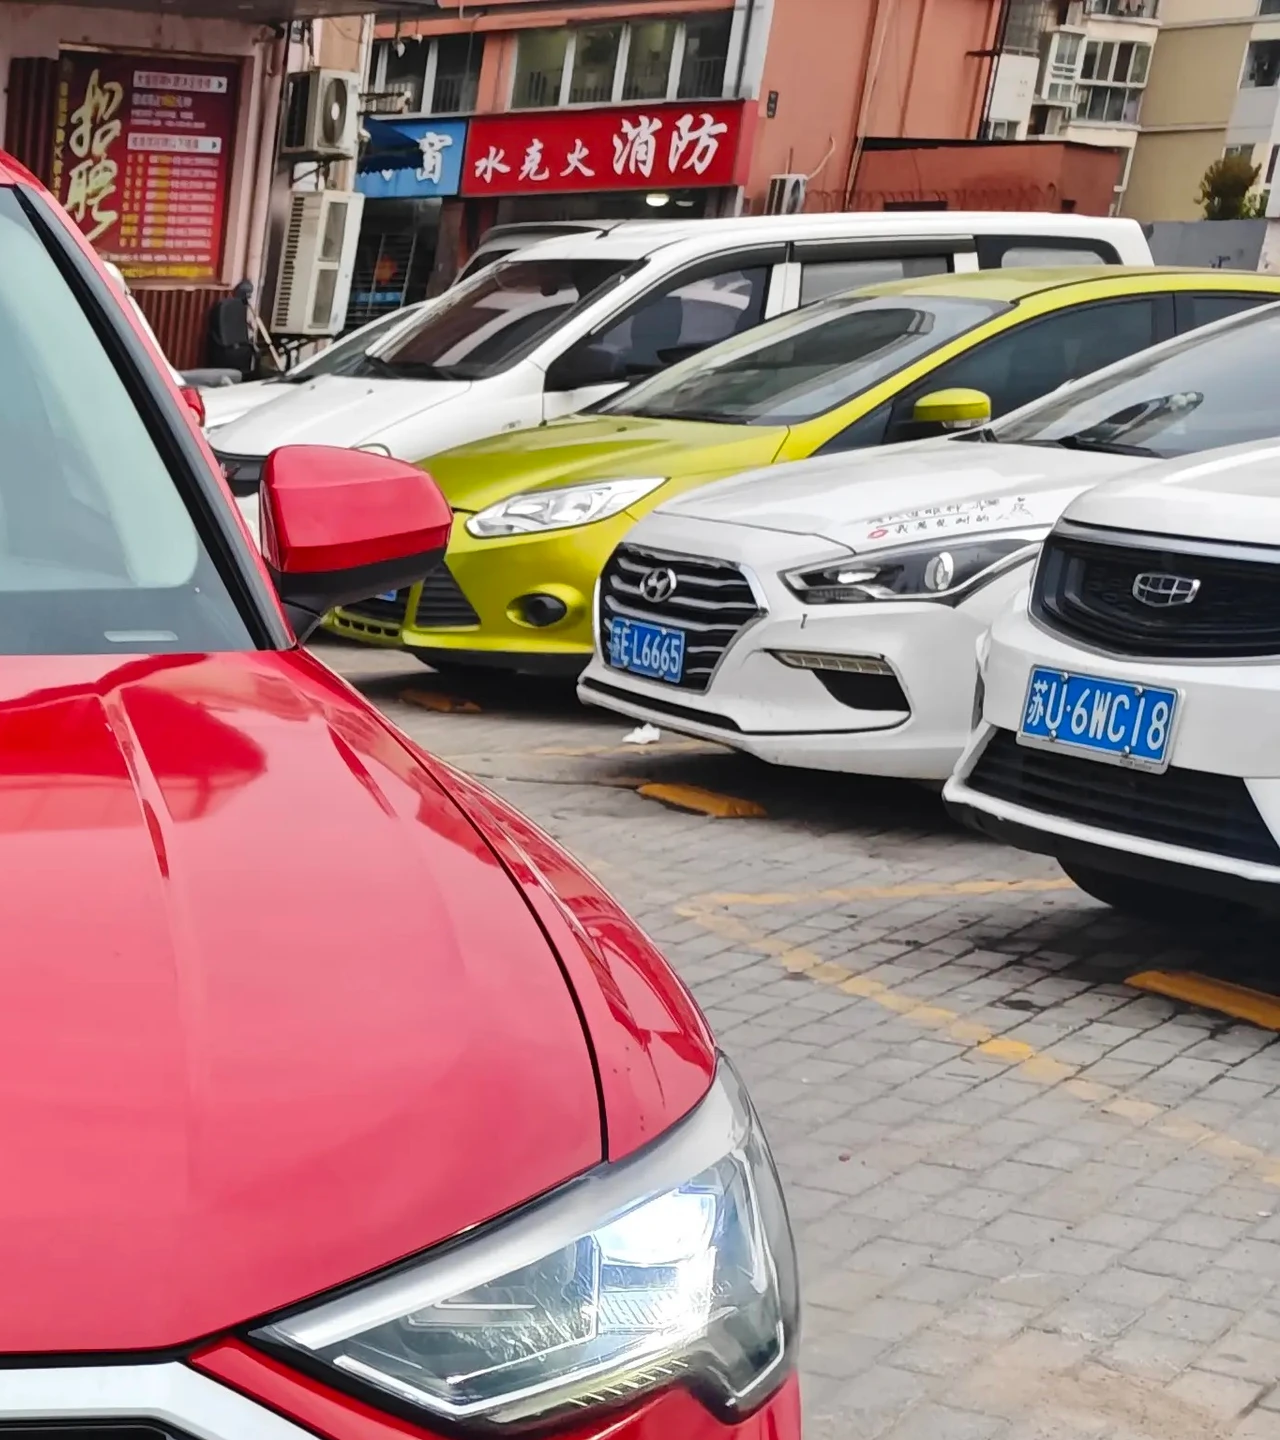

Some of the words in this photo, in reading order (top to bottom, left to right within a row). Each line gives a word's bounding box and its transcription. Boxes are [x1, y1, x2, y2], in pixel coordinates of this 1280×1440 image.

[62, 68, 124, 243] 招聘
[474, 113, 728, 184] 水克火消防
